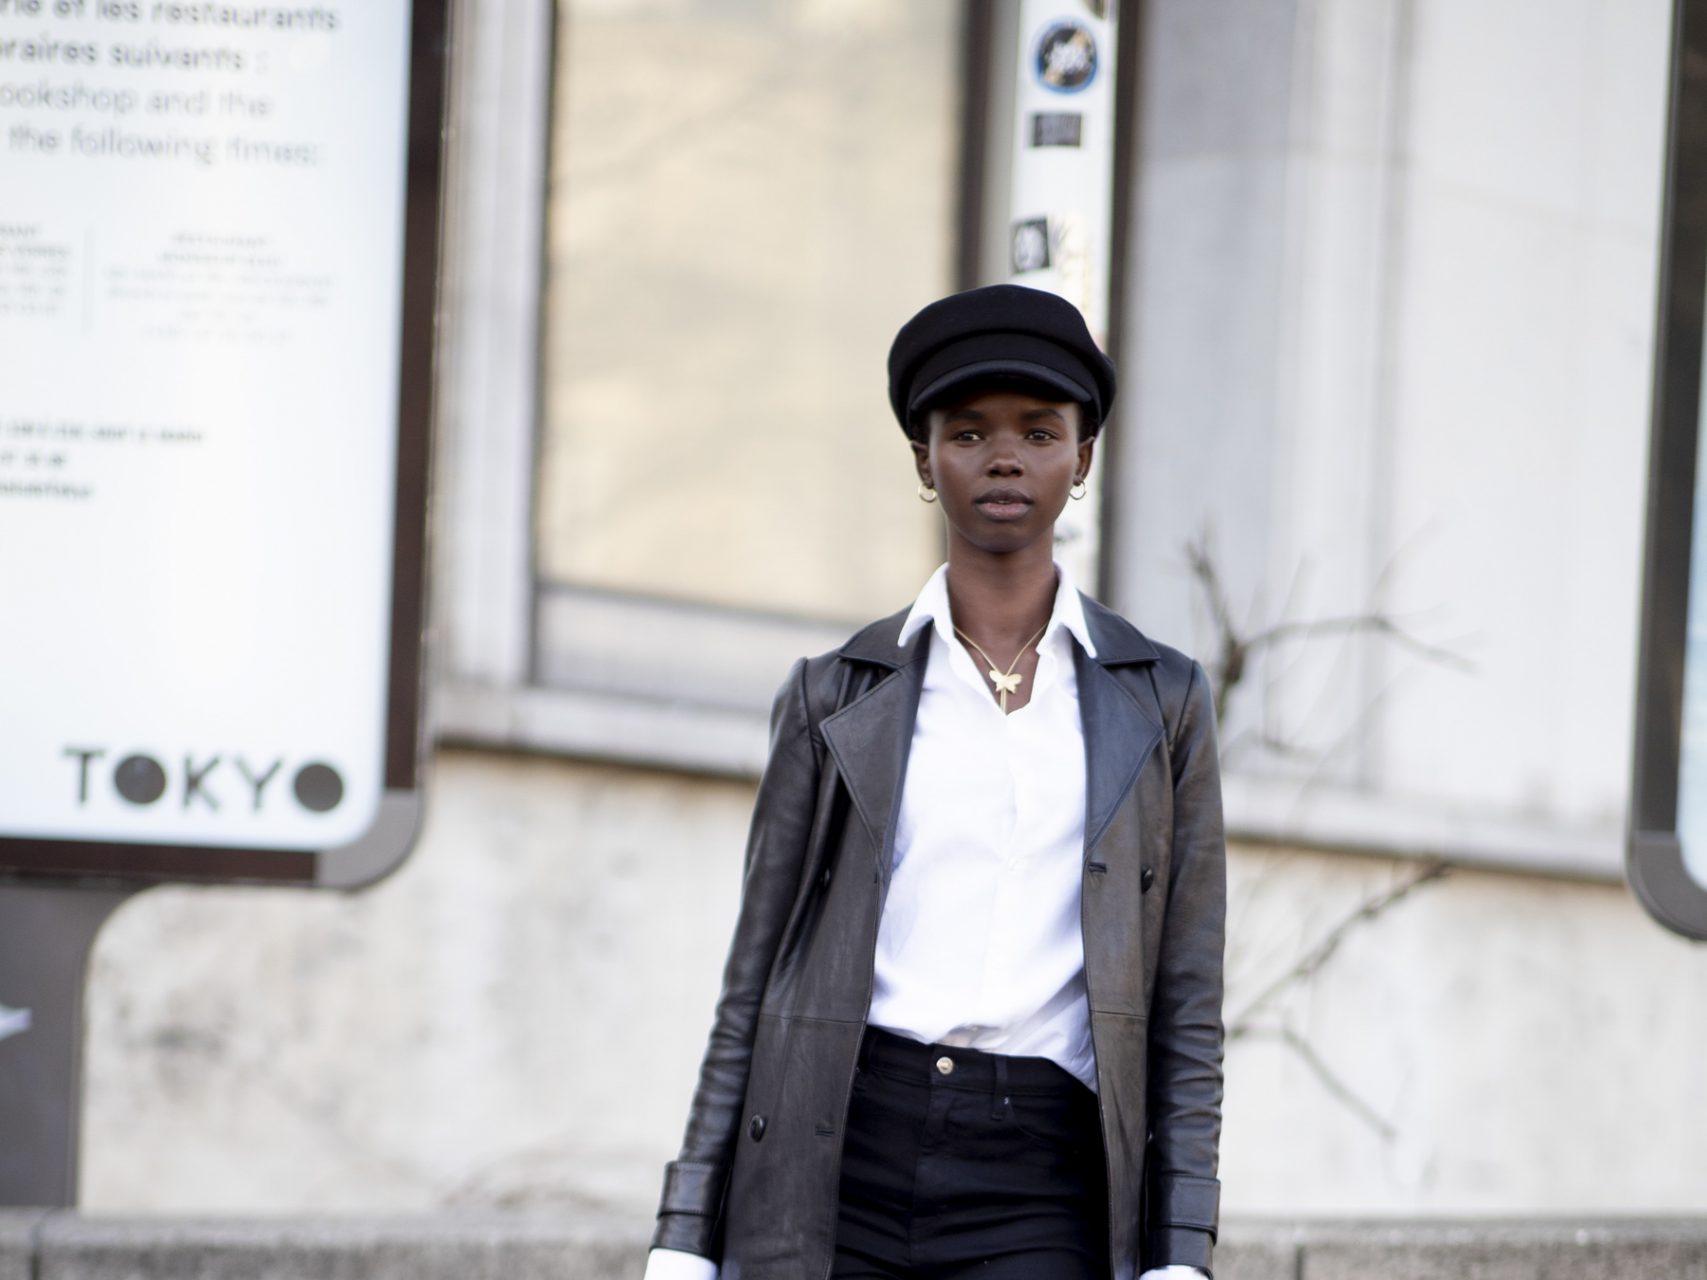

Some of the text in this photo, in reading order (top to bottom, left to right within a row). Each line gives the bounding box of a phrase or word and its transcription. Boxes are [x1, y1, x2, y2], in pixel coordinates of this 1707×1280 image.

[96, 0, 141, 23] les
[151, 0, 340, 32] restaurants
[0, 32, 97, 63] raires
[109, 37, 244, 71] suivants
[147, 89, 206, 116] and
[219, 91, 271, 117] the
[70, 124, 215, 166] following
[64, 747, 344, 812] TOKYO
